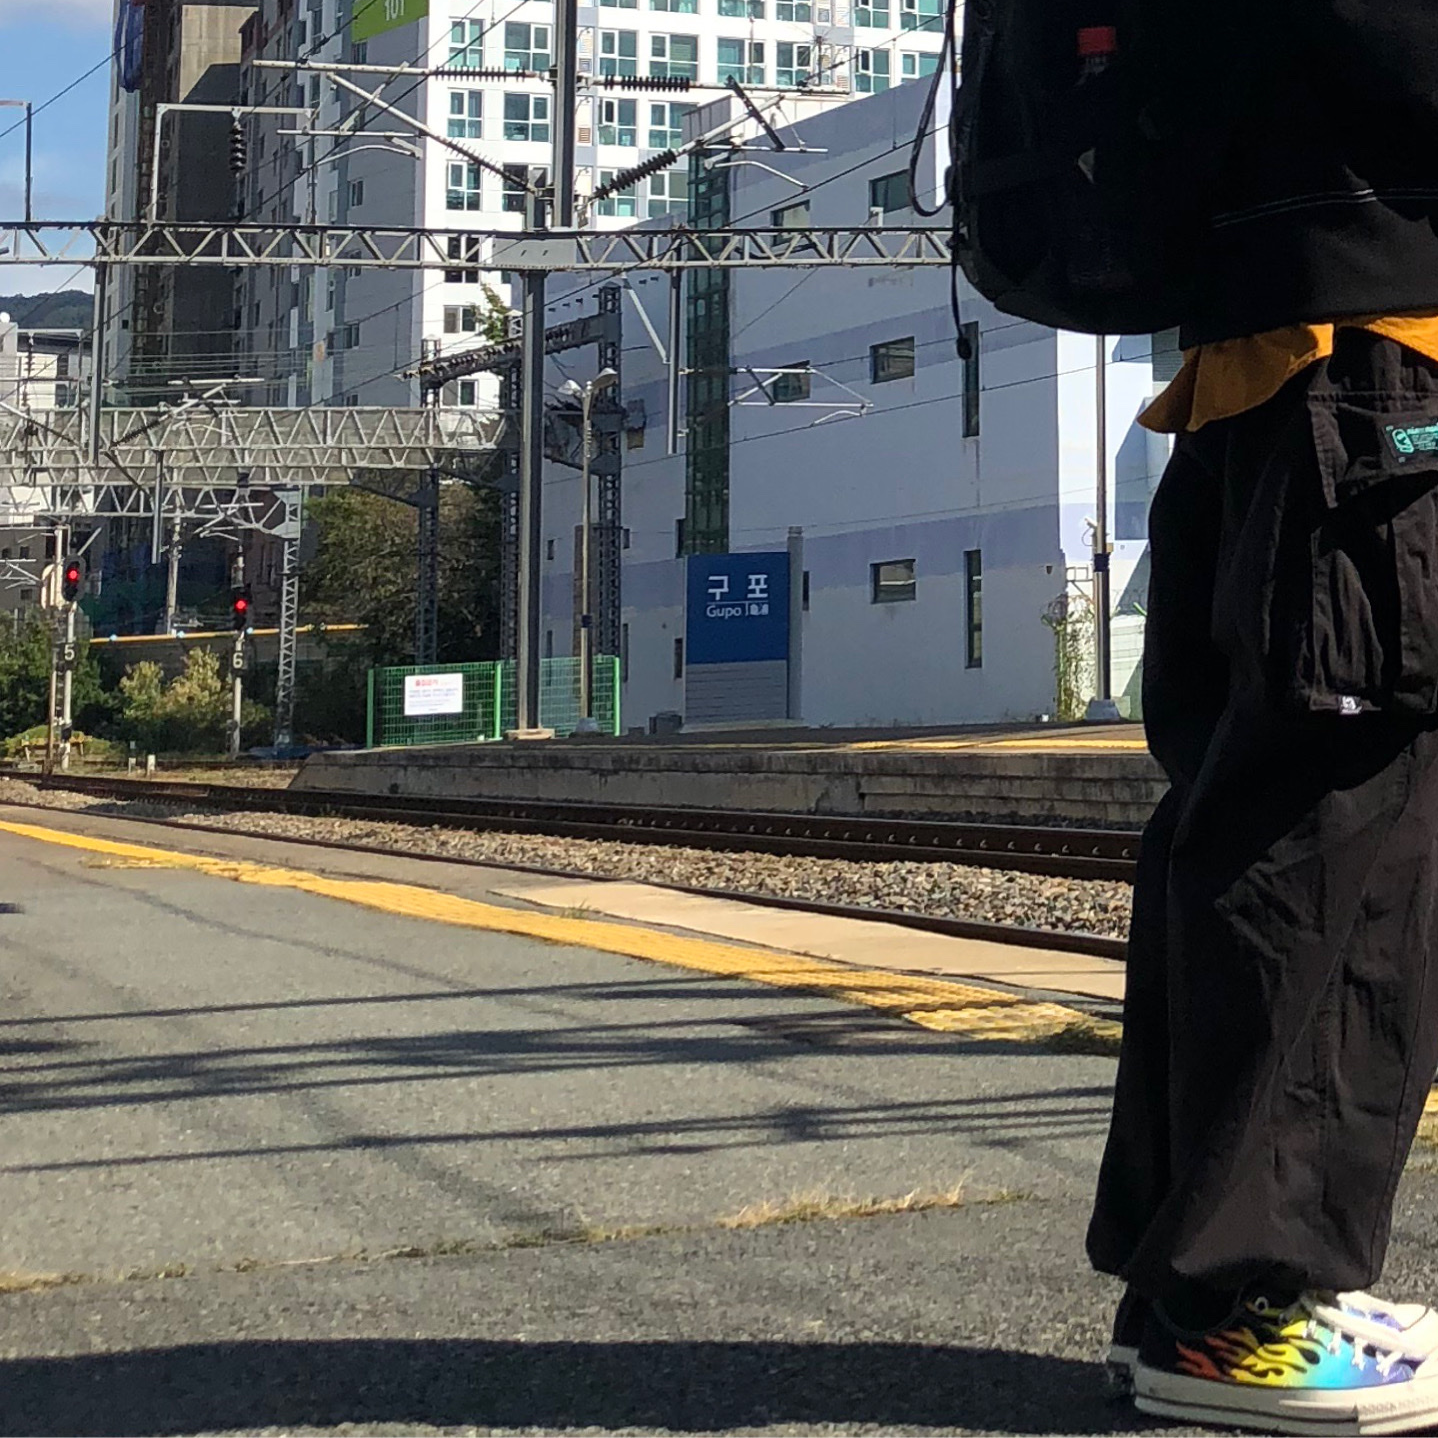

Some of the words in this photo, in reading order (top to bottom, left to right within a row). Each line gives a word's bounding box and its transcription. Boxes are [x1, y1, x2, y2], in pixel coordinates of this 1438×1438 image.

[706, 604, 742, 620] Gupo
[64, 644, 75, 661] 5
[232, 652, 244, 669] 6
